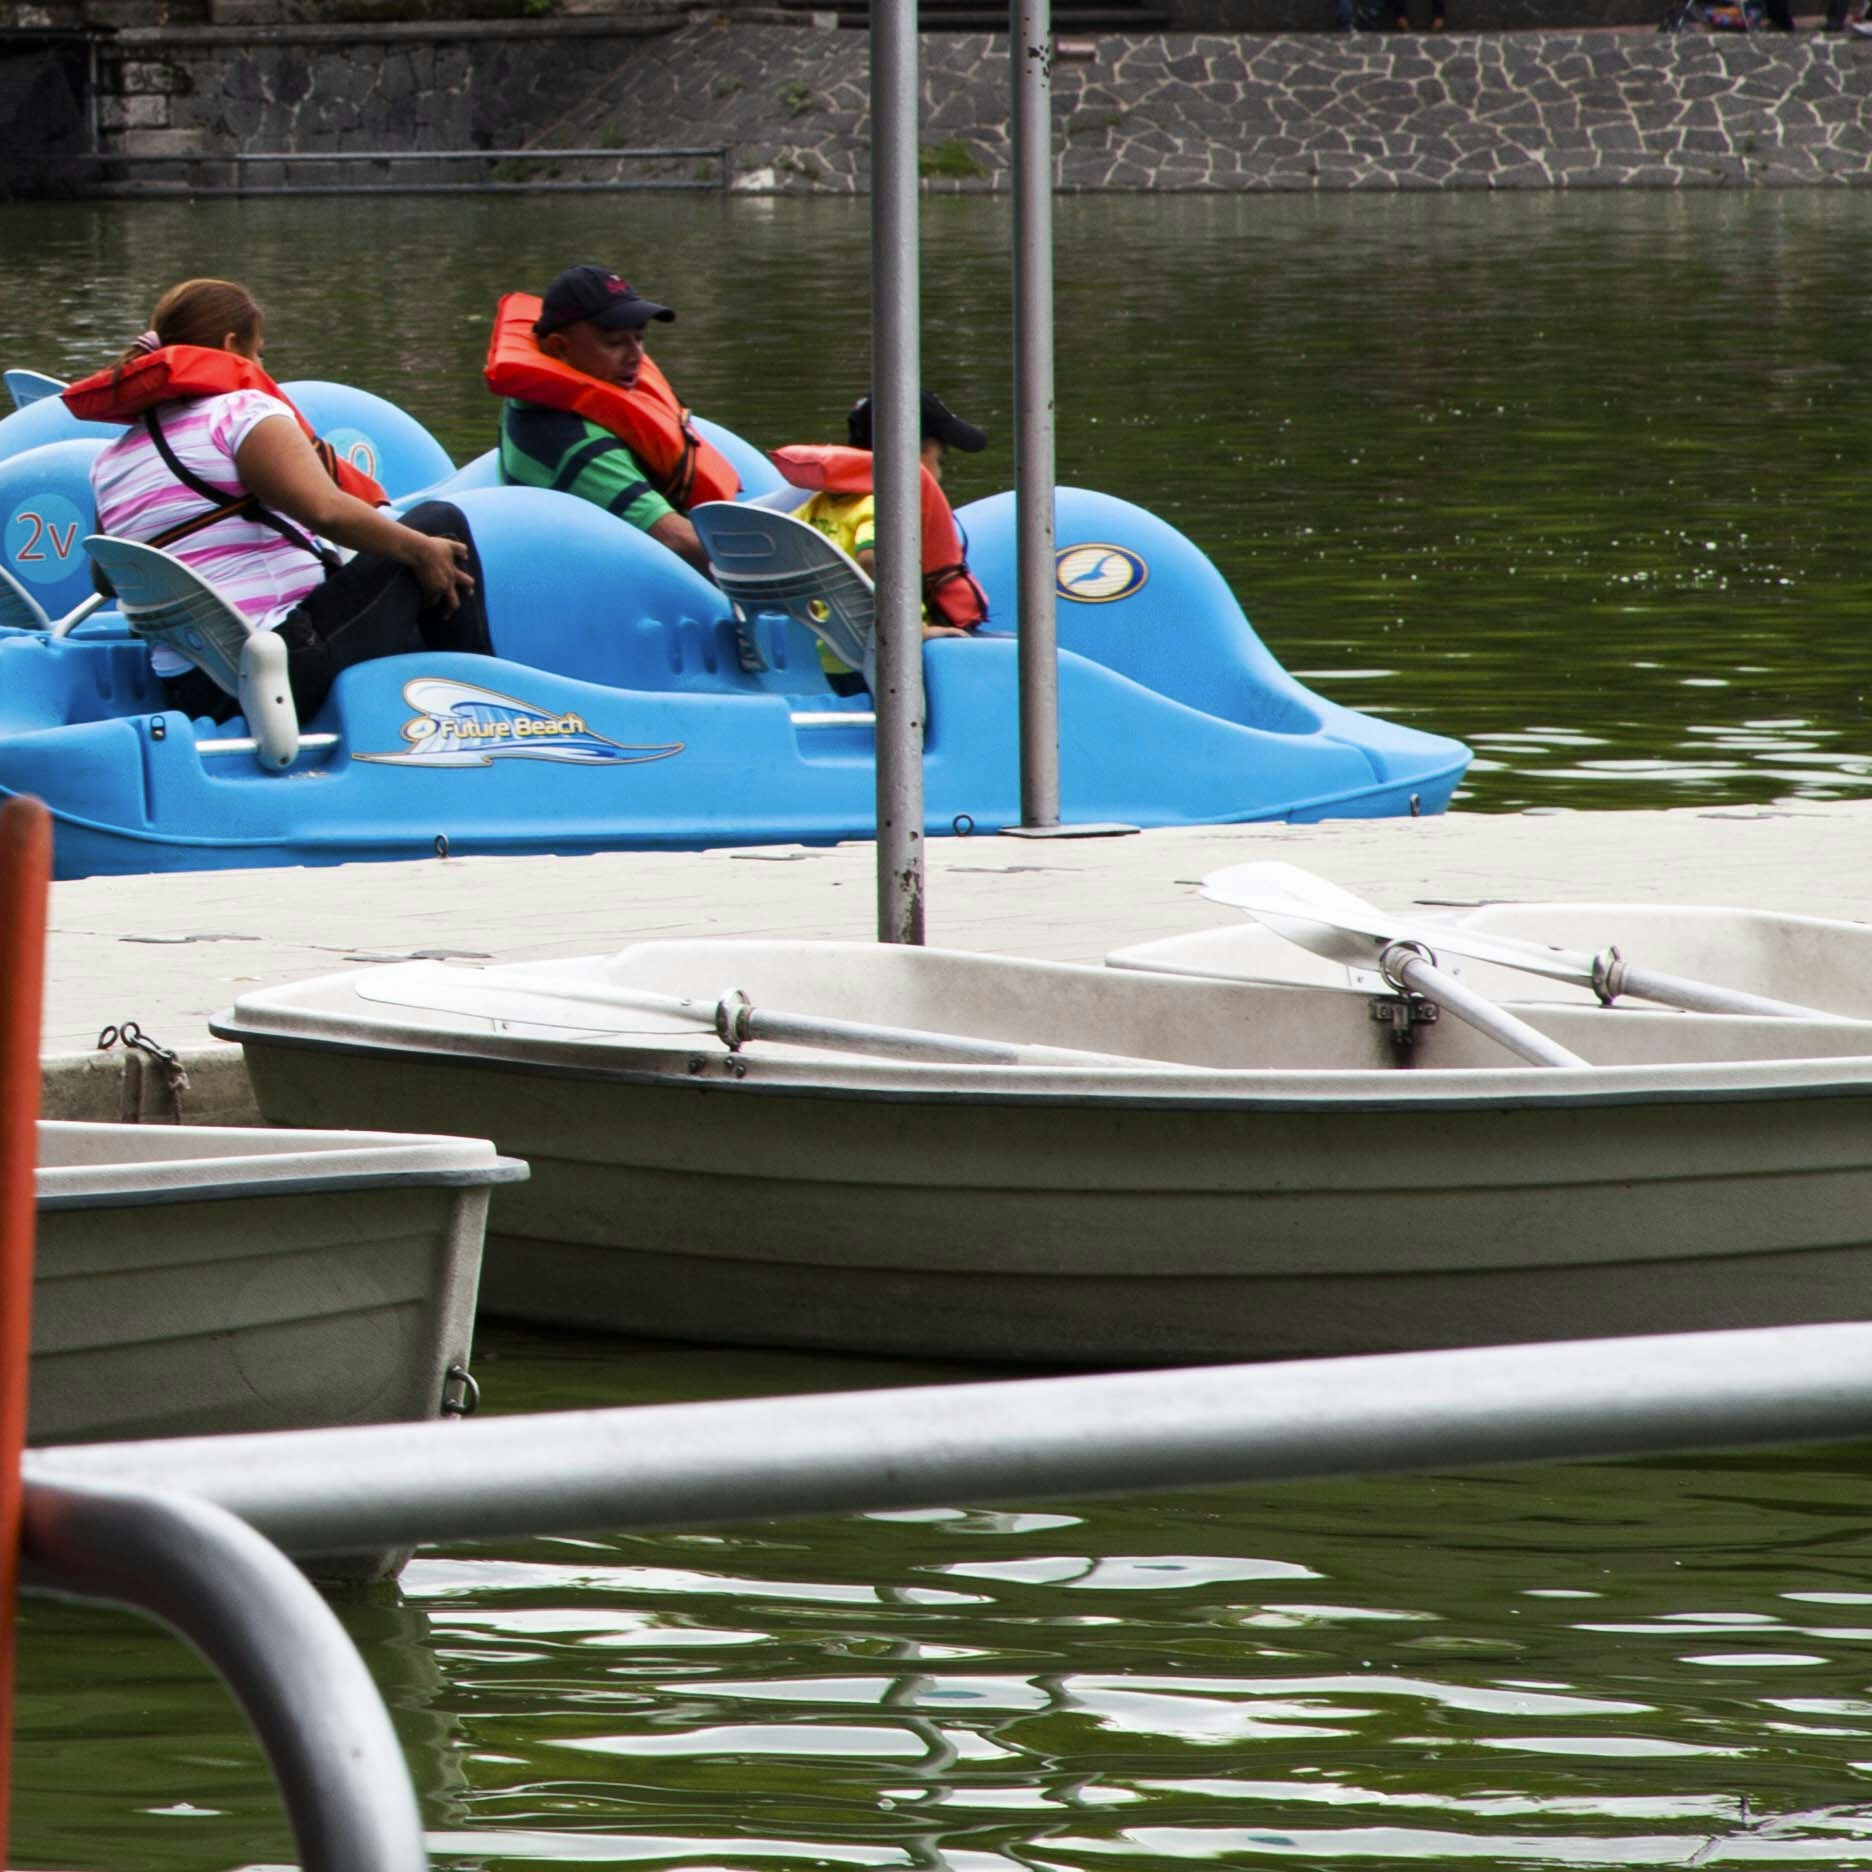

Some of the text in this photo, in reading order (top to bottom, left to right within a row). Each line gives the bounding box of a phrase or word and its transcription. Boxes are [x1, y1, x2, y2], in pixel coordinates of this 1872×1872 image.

[16, 513, 78, 561] 2v
[440, 716, 585, 739] Future Beach
